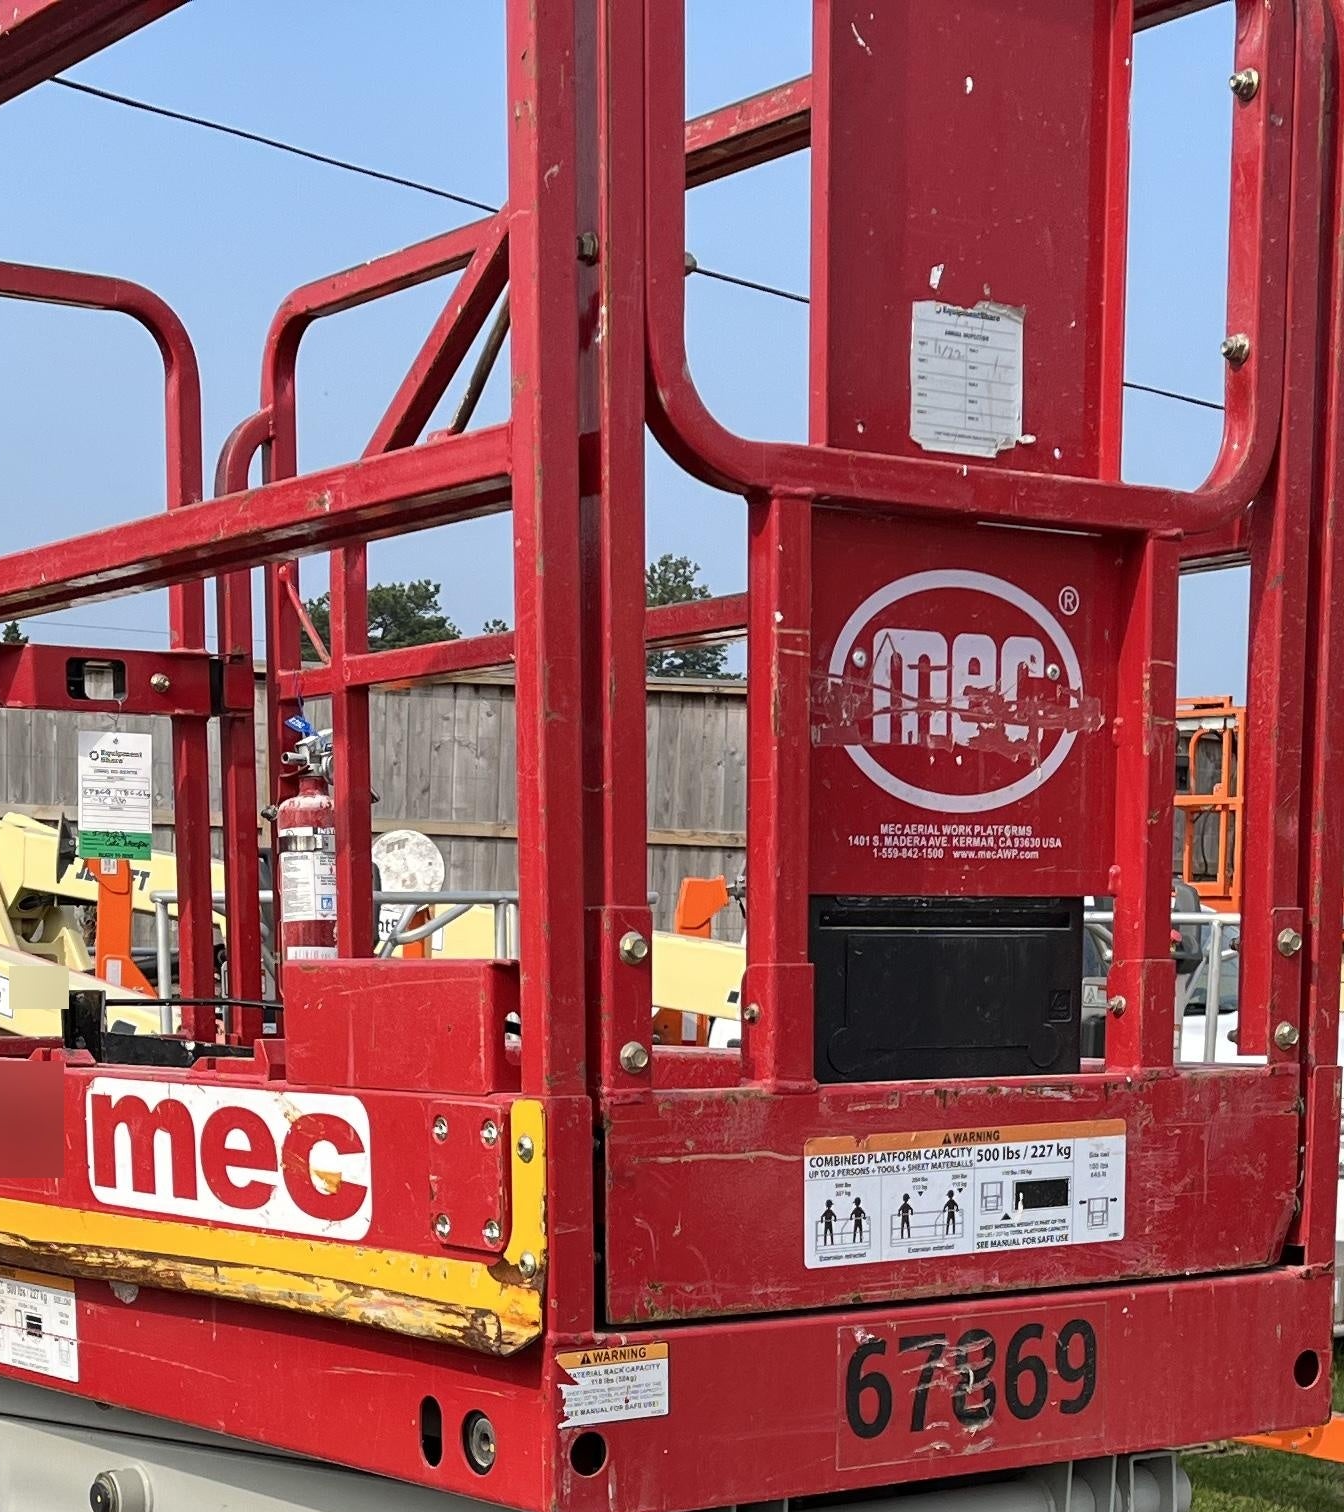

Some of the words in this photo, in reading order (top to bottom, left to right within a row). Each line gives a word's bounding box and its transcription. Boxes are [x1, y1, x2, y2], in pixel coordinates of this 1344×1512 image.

[880, 823, 903, 835] MEC
[903, 823, 940, 836] AERIAL
[942, 824, 973, 836] WORK
[974, 824, 1033, 837] PLATFORMS
[848, 835, 870, 847] 1401
[872, 836, 883, 847] S.
[884, 836, 927, 847] MADERA
[928, 836, 951, 847] AVE.
[952, 836, 998, 849] KERMAN,
[998, 836, 1013, 848] CA
[1013, 836, 1040, 848] 93630
[1042, 837, 1062, 849] USA
[872, 848, 944, 859] 1-559-842-1500
[952, 848, 1039, 860] www.mecAWP.com
[952, 1130, 1001, 1144] WARNING
[90, 1093, 368, 1222] mec
[809, 1155, 865, 1168] COMBINED
[867, 1150, 922, 1164] PLATFORM
[923, 1146, 973, 1160] CAPACITY
[976, 1147, 1000, 1163] 500
[1002, 1145, 1021, 1161] lbs
[1023, 1145, 1029, 1160] /
[1030, 1144, 1054, 1159] 227
[1056, 1142, 1072, 1160] kg
[808, 1170, 819, 1178] UP
[820, 1169, 830, 1178] TO
[831, 1169, 836, 1177] 2
[836, 1166, 870, 1177] PERSONS
[877, 1164, 900, 1174] TOOLS
[907, 1163, 929, 1173] SHEET
[976, 1240, 989, 1249] SEE
[990, 1237, 1021, 1248] MANUAL
[1021, 1236, 1036, 1245] FOR
[1037, 1234, 1053, 1244] SAFE
[1055, 1233, 1069, 1242] USE
[592, 1347, 647, 1363] WARNING
[603, 1366, 624, 1375] RACK
[624, 1363, 661, 1374] CAPACITY
[845, 1318, 1098, 1440] 67869
[580, 1407, 609, 1416] MANUAL
